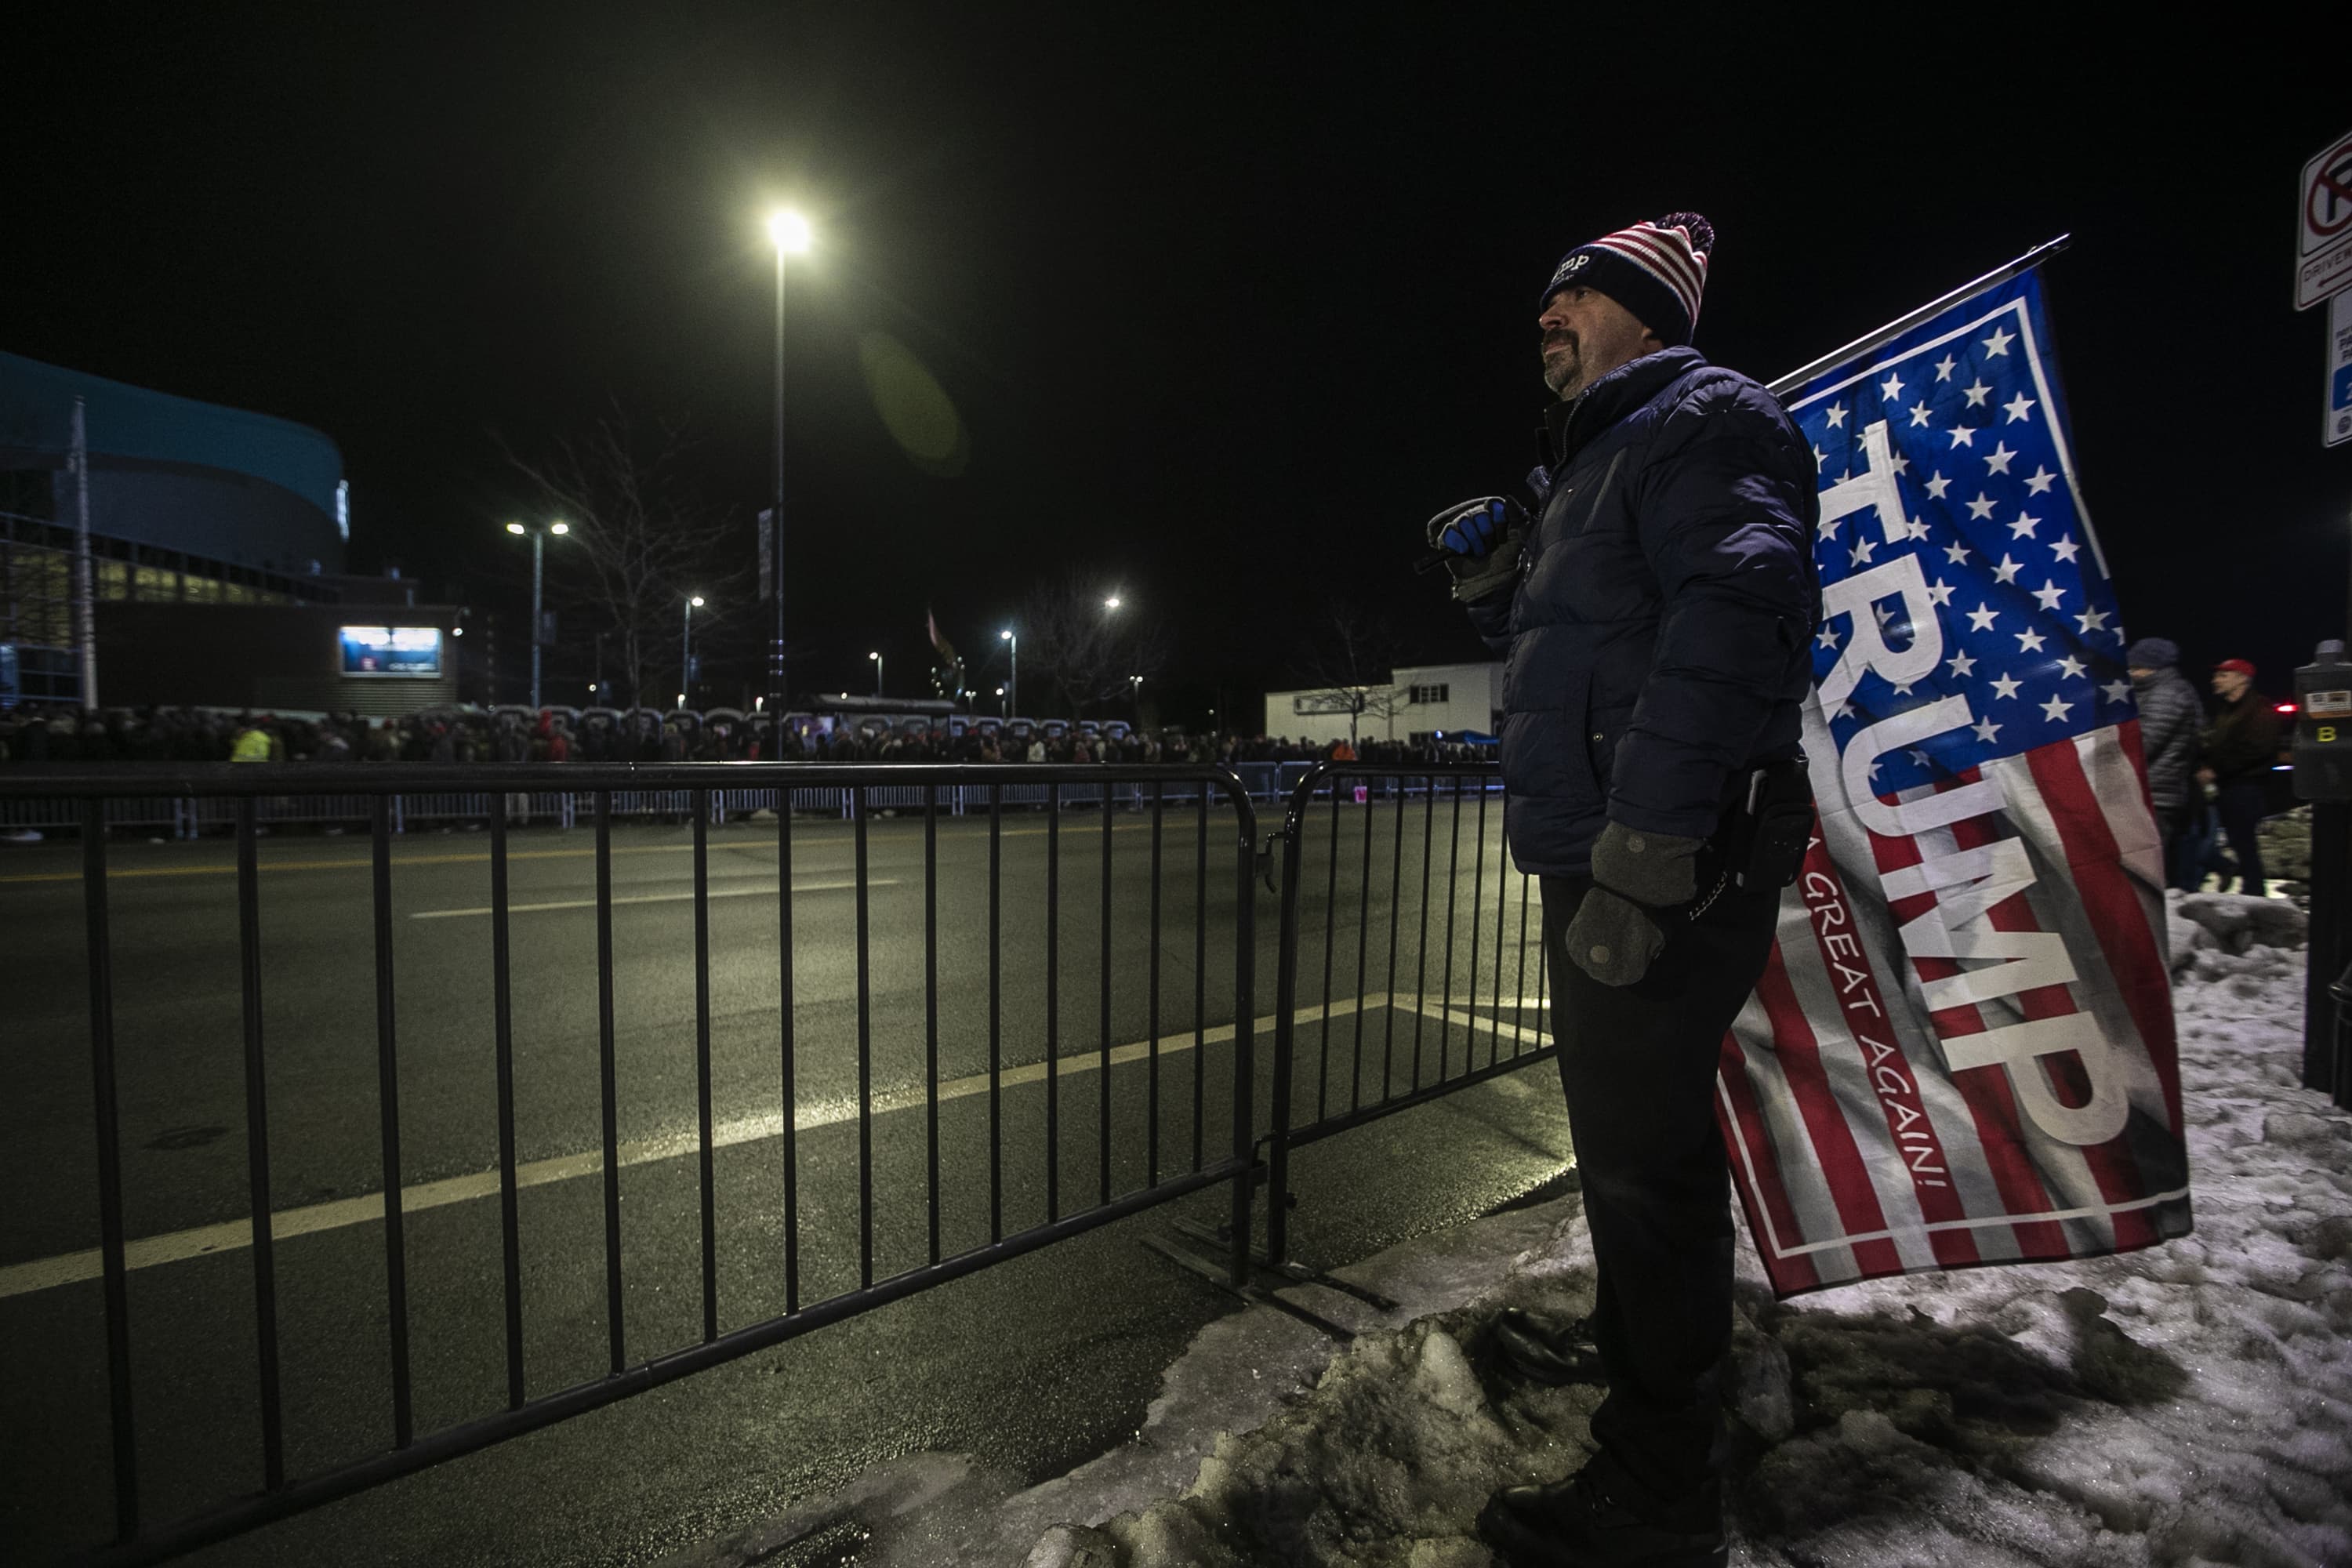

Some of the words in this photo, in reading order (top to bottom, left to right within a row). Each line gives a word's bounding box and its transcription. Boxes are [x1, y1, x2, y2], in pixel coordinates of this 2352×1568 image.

[1817, 419, 2129, 1146] TRUMP
[2317, 727, 2337, 742] B
[1806, 872, 1881, 1018] GREAT
[1860, 1034, 1947, 1188] AGAIN!
